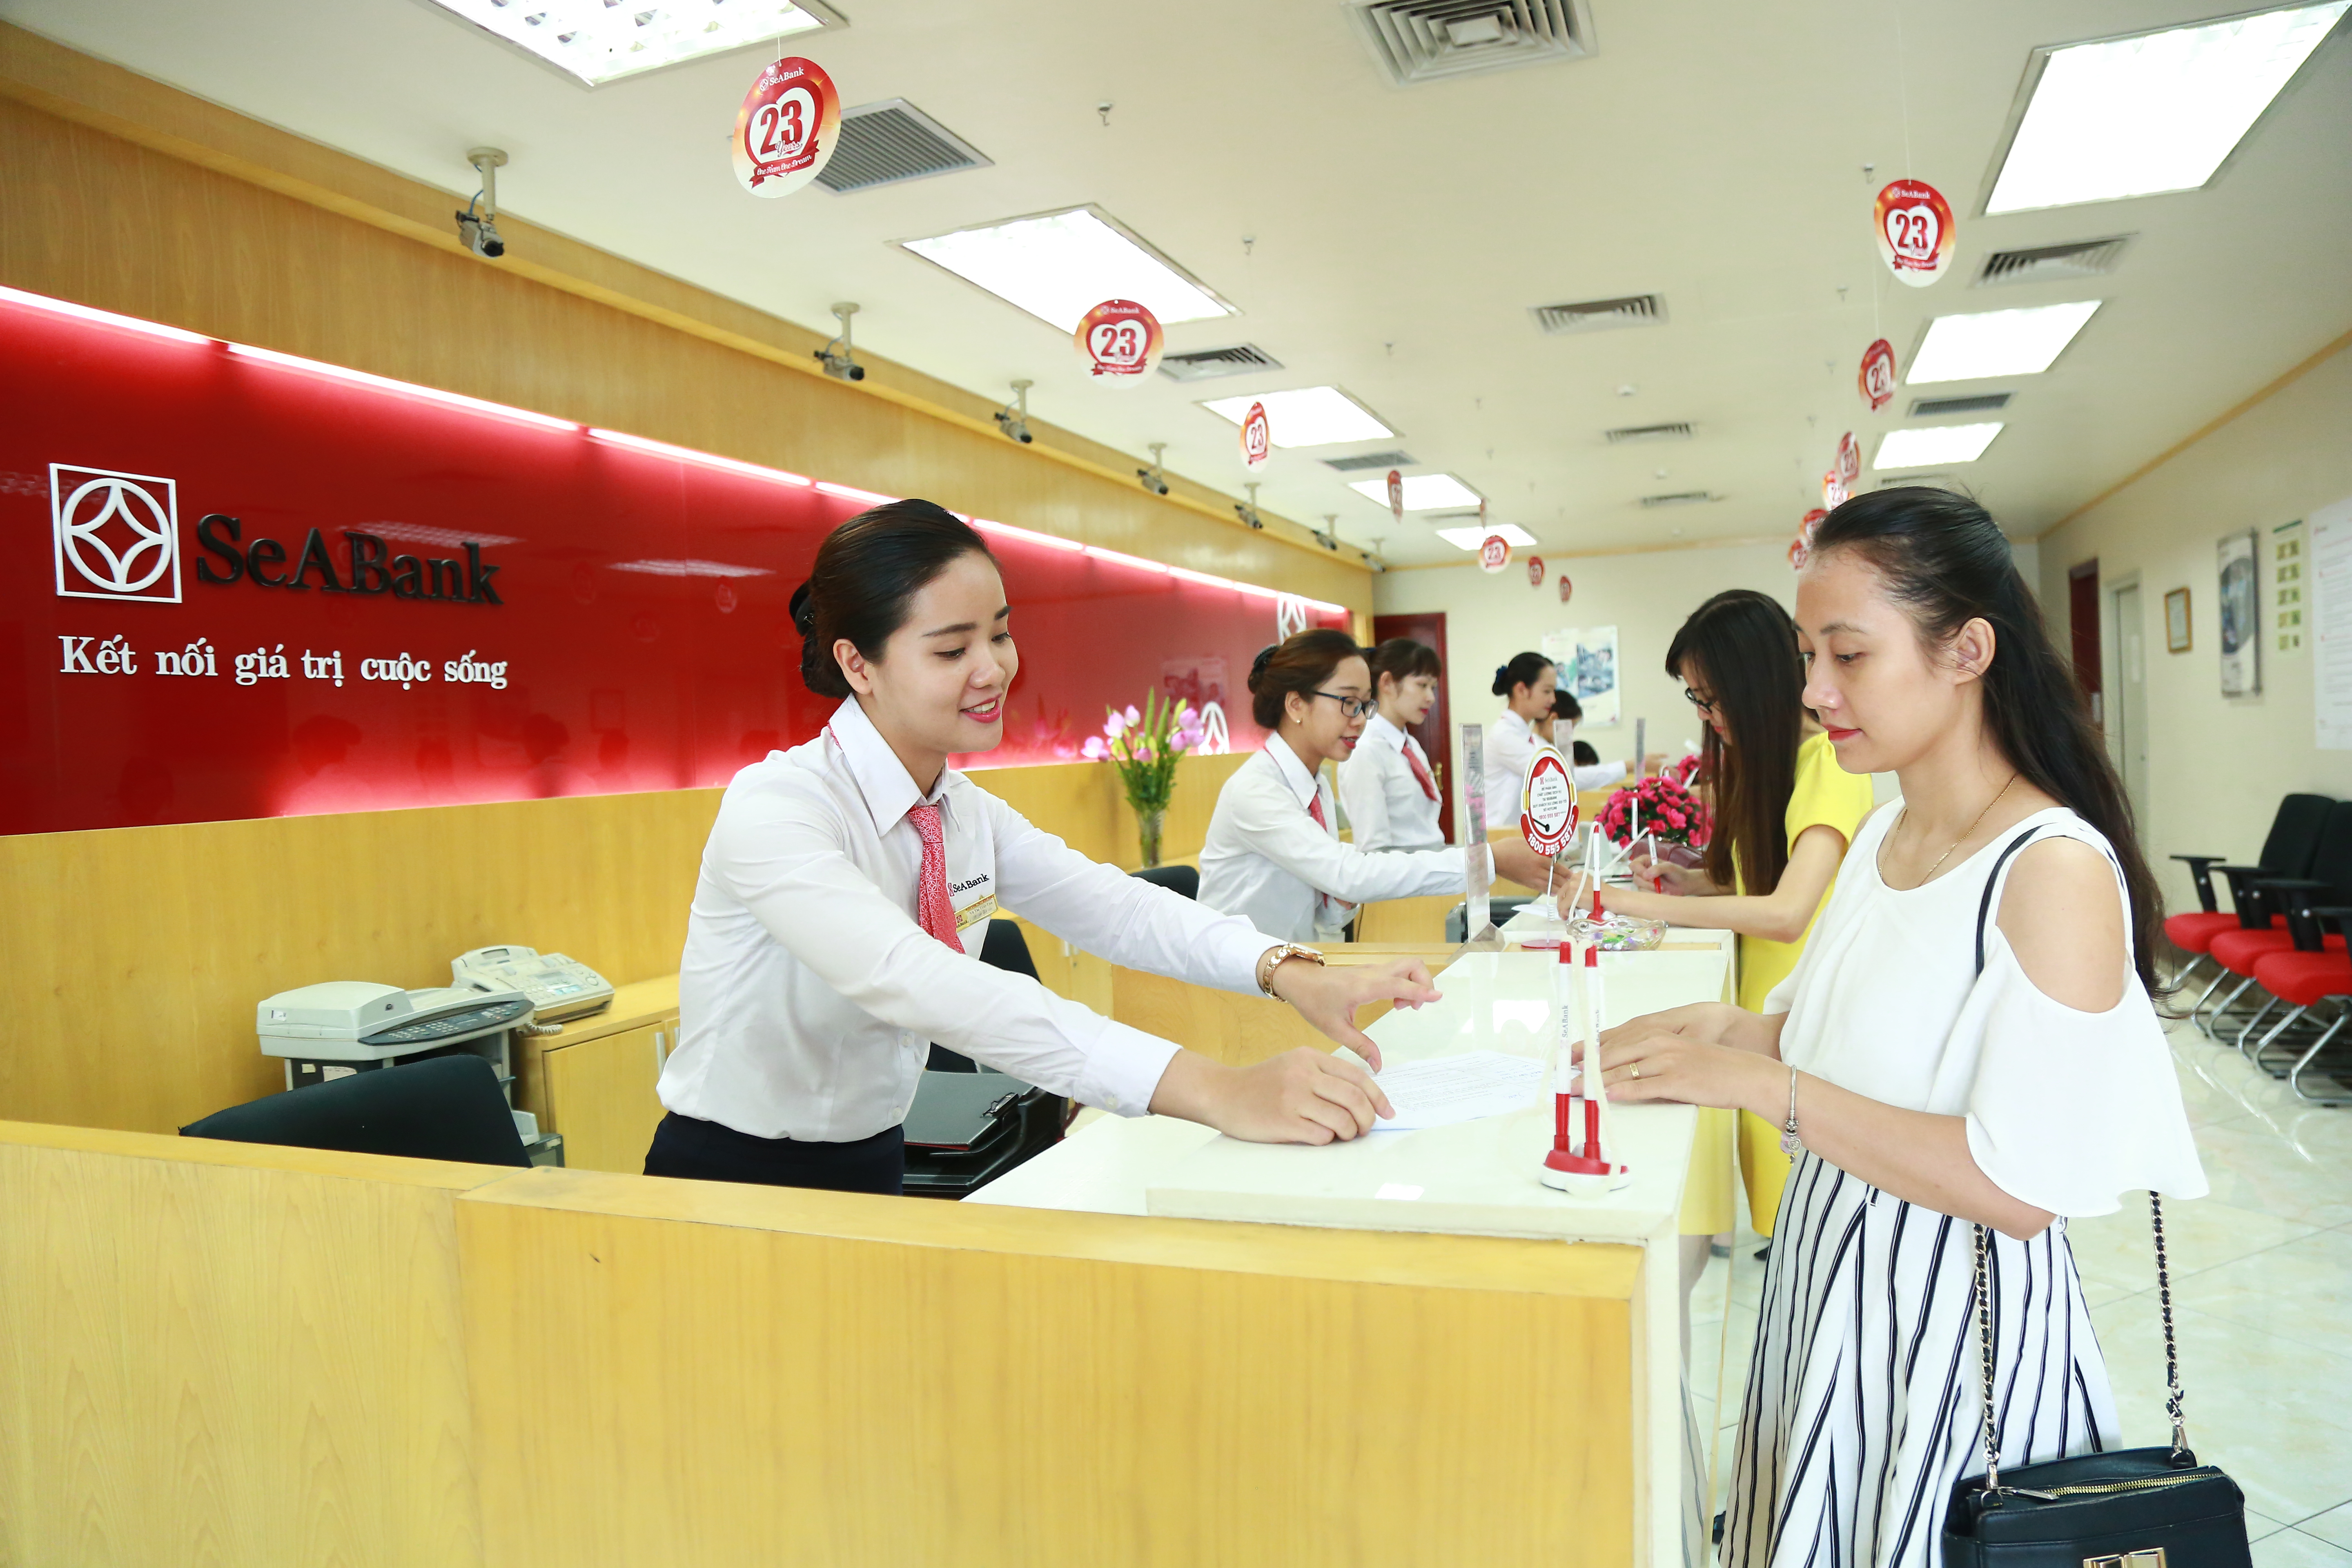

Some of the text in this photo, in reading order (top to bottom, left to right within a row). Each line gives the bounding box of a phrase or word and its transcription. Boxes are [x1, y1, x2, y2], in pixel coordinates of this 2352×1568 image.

[769, 67, 804, 86] SeABank
[760, 100, 803, 155] 23
[1896, 214, 1927, 249] 23
[1101, 328, 1136, 356] 23
[1251, 425, 1263, 450] 23
[197, 514, 504, 605] SeABank
[58, 635, 508, 690] Kết nối giá trị cuộc sống
[1528, 825, 1572, 855] 1800 555 587
[953, 873, 990, 893] SeABank
